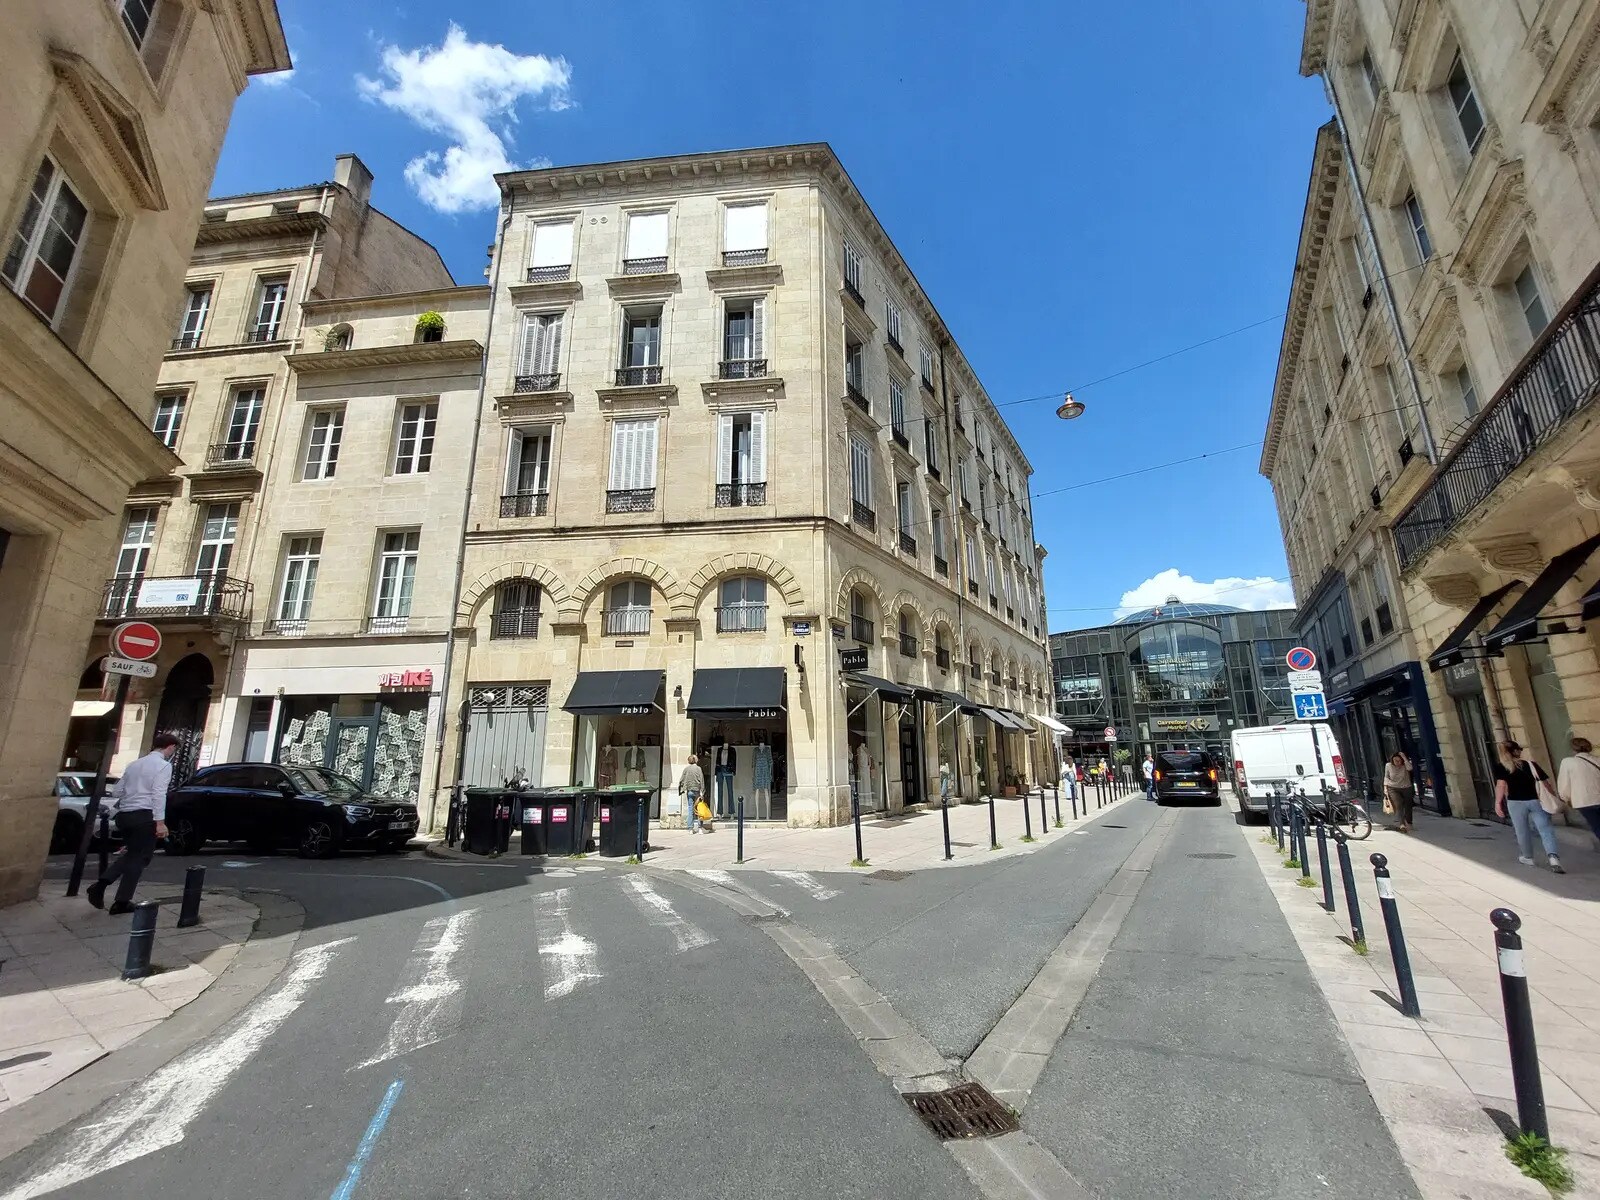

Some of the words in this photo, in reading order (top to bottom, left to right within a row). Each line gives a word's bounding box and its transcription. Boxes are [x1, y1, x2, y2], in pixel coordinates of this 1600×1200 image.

[843, 655, 866, 665] Pablo
[111, 661, 134, 671] SAUF
[621, 706, 649, 714] Pablo
